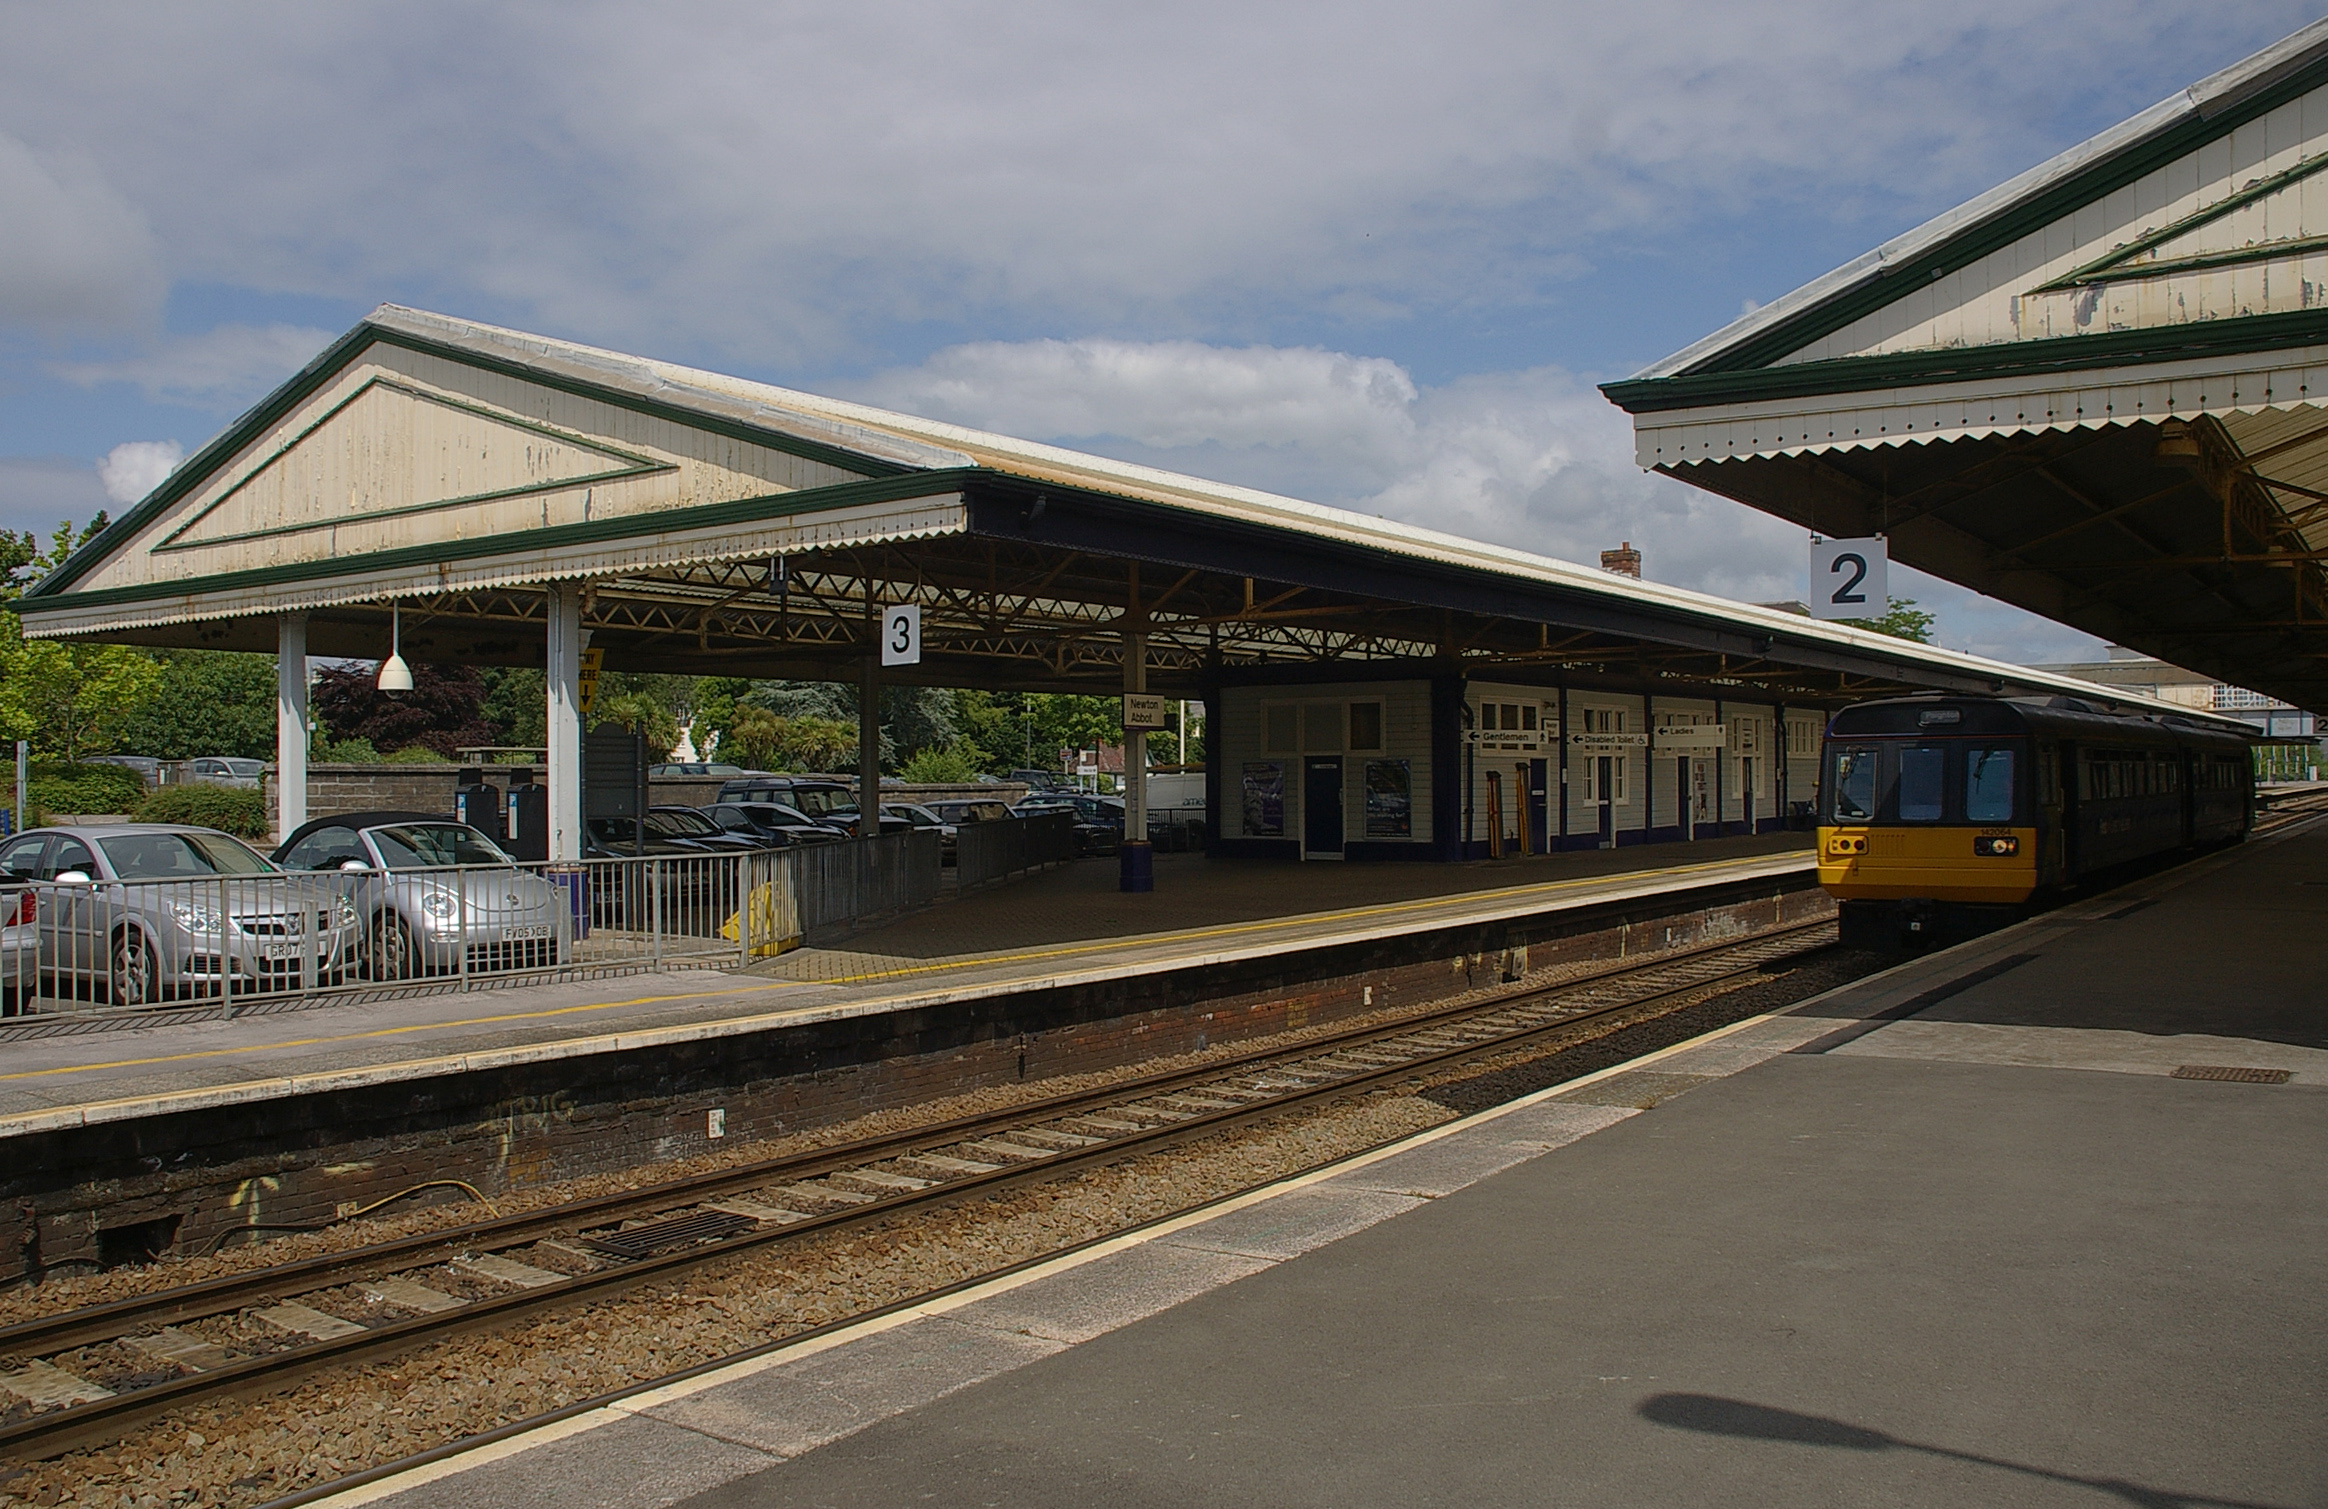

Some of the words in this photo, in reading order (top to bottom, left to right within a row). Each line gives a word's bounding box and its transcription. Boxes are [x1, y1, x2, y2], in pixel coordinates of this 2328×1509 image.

[1831, 553, 1867, 604] 2
[892, 616, 910, 654] 3
[1130, 698, 1159, 710] Newton
[1131, 712, 1153, 723] Abbot
[2318, 719, 2328, 731] 2
[1483, 732, 1529, 741] Gentlemen
[1585, 735, 1615, 743] Disabled
[1980, 828, 2011, 836] 142064
